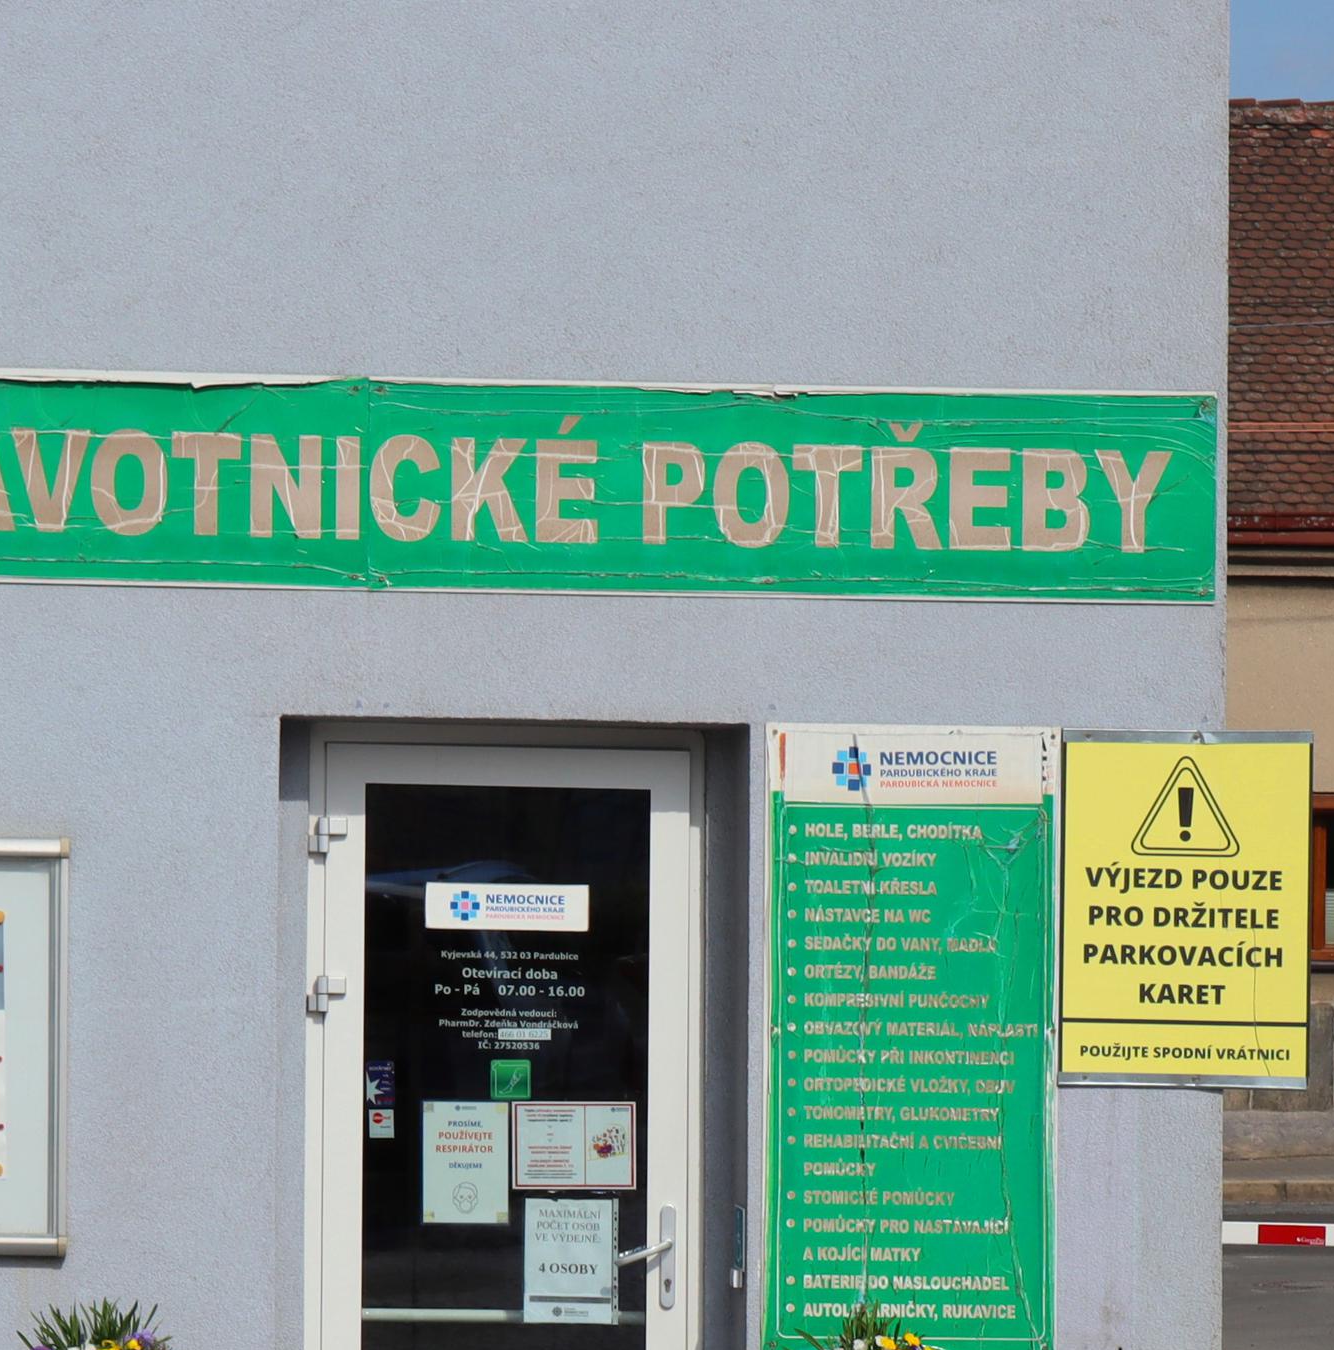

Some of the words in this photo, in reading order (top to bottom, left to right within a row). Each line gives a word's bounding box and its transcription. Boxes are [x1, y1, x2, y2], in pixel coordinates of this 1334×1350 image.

[642, 423, 1172, 555] POTŘEBY
[879, 750, 998, 766] NEMOCNICE
[879, 767, 962, 778] PARDUBICKÉHO
[965, 768, 998, 778] KRAJE
[942, 780, 998, 789] NEMOCNICE
[804, 823, 848, 840] HOLE,
[852, 823, 903, 841] BERLE,
[906, 821, 984, 840] CHODÍTKA
[804, 850, 878, 866] INVALIDNÍ
[882, 849, 937, 867] VOZÍKY
[1085, 862, 1183, 893] VÝJEZD
[1192, 868, 1283, 891] POUZE
[880, 877, 937, 896] KŘESLA
[485, 893, 565, 906] NEMOCNICE
[543, 906, 565, 914] KRAJE
[804, 904, 880, 923] NÁSTAVCE
[884, 909, 905, 922] NA
[908, 909, 932, 923] WC
[1088, 905, 1144, 927] PRO
[1153, 901, 1280, 930] DRŽITELE
[804, 933, 872, 951] SEDAČKY
[876, 937, 897, 951] DO
[901, 938, 942, 954] VANY,
[440, 950, 482, 961] Kyjevská
[484, 951, 499, 960] 44,
[501, 951, 518, 960] 532
[520, 951, 532, 960] 03
[533, 951, 579, 961] Pardubice
[1083, 941, 1284, 968] PARKOVACÍCH
[462, 966, 522, 980] Otevírací
[526, 968, 558, 980] doba
[868, 963, 936, 980] BANDÁŽE
[434, 983, 452, 995] Po
[463, 983, 480, 995] Pá
[498, 985, 536, 996] 07.00
[548, 986, 585, 997] 16.00
[1138, 983, 1226, 1005] KARET
[804, 991, 905, 1008] KOMPRESIVNÍ
[460, 1007, 517, 1018] Zodpovědná
[518, 1008, 558, 1018] vedoucí:
[438, 1019, 483, 1028] PharmDr.
[519, 1020, 579, 1030] Vondráčková
[462, 1030, 498, 1039] telefon:
[880, 1047, 904, 1064] PŘI
[1080, 1042, 1149, 1061] POUŽIJTE
[1153, 1043, 1215, 1060] SPODNÍ
[1216, 1043, 1291, 1061] VRÁTNICI
[804, 1106, 895, 1122] TONOMETRY,
[900, 1107, 999, 1122] GLUKOMETRY
[438, 1130, 493, 1141] POUŽÍVEJTE
[918, 1135, 929, 1149] A
[435, 1143, 493, 1153] RESPIRÁTOR
[803, 1158, 876, 1177] POMŮCKY
[882, 1188, 955, 1206] POMŮCKY
[536, 1220, 569, 1231] POČET
[571, 1222, 600, 1231] OSOB
[803, 1214, 875, 1233] POMŮCKY
[880, 1219, 909, 1233] PRO
[535, 1232, 548, 1241] VE
[803, 1246, 814, 1260] A
[870, 1247, 922, 1261] MATKY
[538, 1262, 546, 1273] 4
[549, 1262, 598, 1274] OSOBY
[803, 1274, 866, 1289] BATERIE
[868, 1275, 889, 1289] DO
[893, 1275, 1010, 1291] NASLOUCHADEL
[942, 1303, 1016, 1320] RUKAVICE
